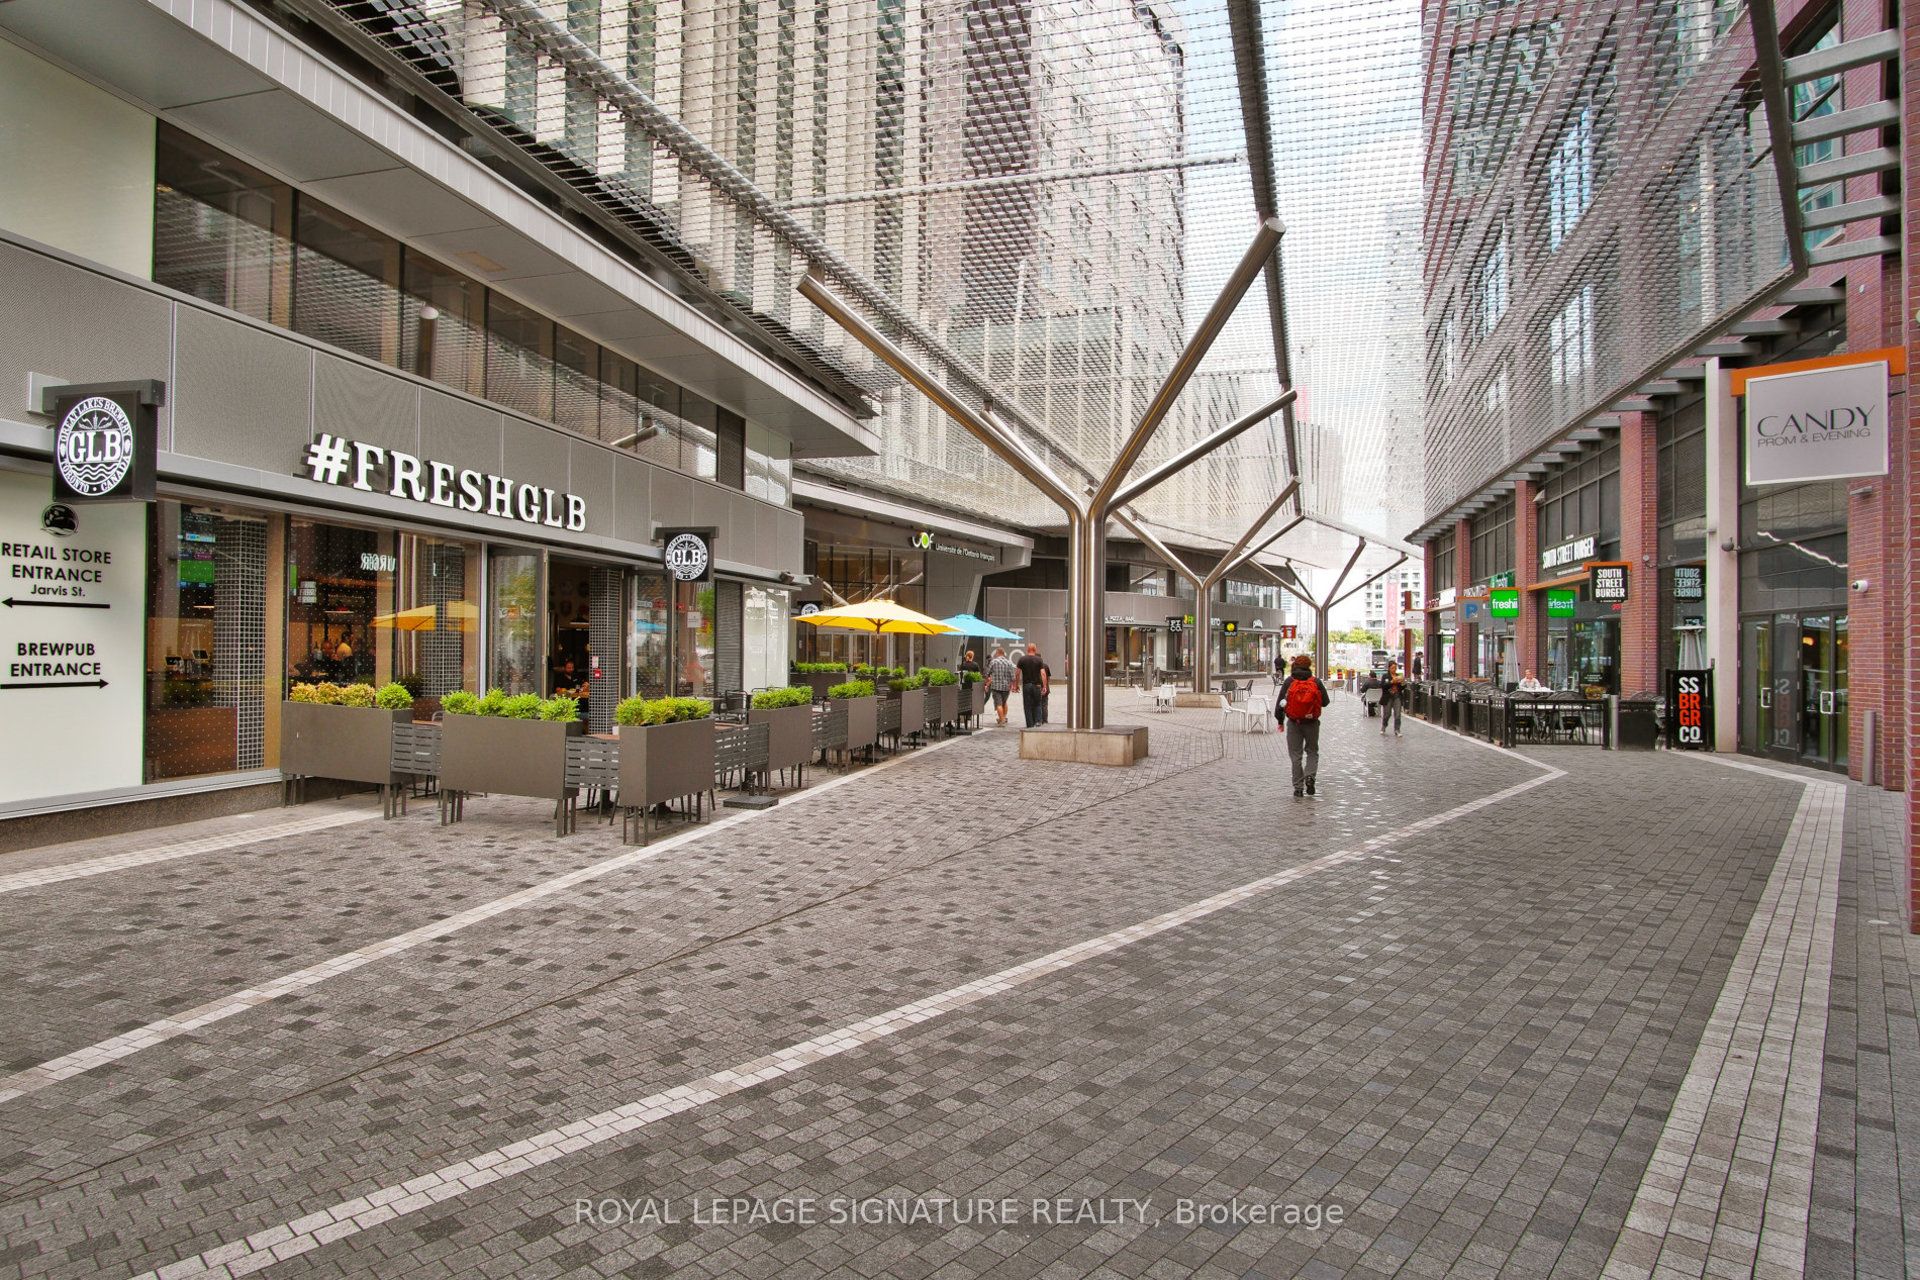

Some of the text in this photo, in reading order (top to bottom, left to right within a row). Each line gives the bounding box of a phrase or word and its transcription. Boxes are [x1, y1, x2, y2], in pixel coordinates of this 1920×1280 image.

[78, 399, 104, 415] LAKES
[104, 400, 131, 437] BREWERY
[1757, 405, 1875, 437] CANDY
[1757, 428, 1871, 448] PROM & EVENING
[69, 431, 121, 463] GLB
[61, 455, 131, 493] TORONTO CANADA
[306, 432, 586, 532] #FRESHGLB
[2, 542, 111, 564] RETAIL STORE
[672, 550, 700, 565] GLB
[12, 564, 102, 583] ENTRANCE
[1597, 569, 1622, 578] SOUTH
[31, 584, 86, 597] Jarvis St.
[1596, 578, 1623, 588] STREET
[1595, 588, 1625, 597] BURGER
[1492, 599, 1518, 609] freshii
[17, 643, 95, 656] BREWPUB
[11, 662, 101, 677] ENTRANCE
[1679, 676, 1699, 693] SS
[1679, 693, 1700, 709] BR
[1679, 709, 1700, 726] GR
